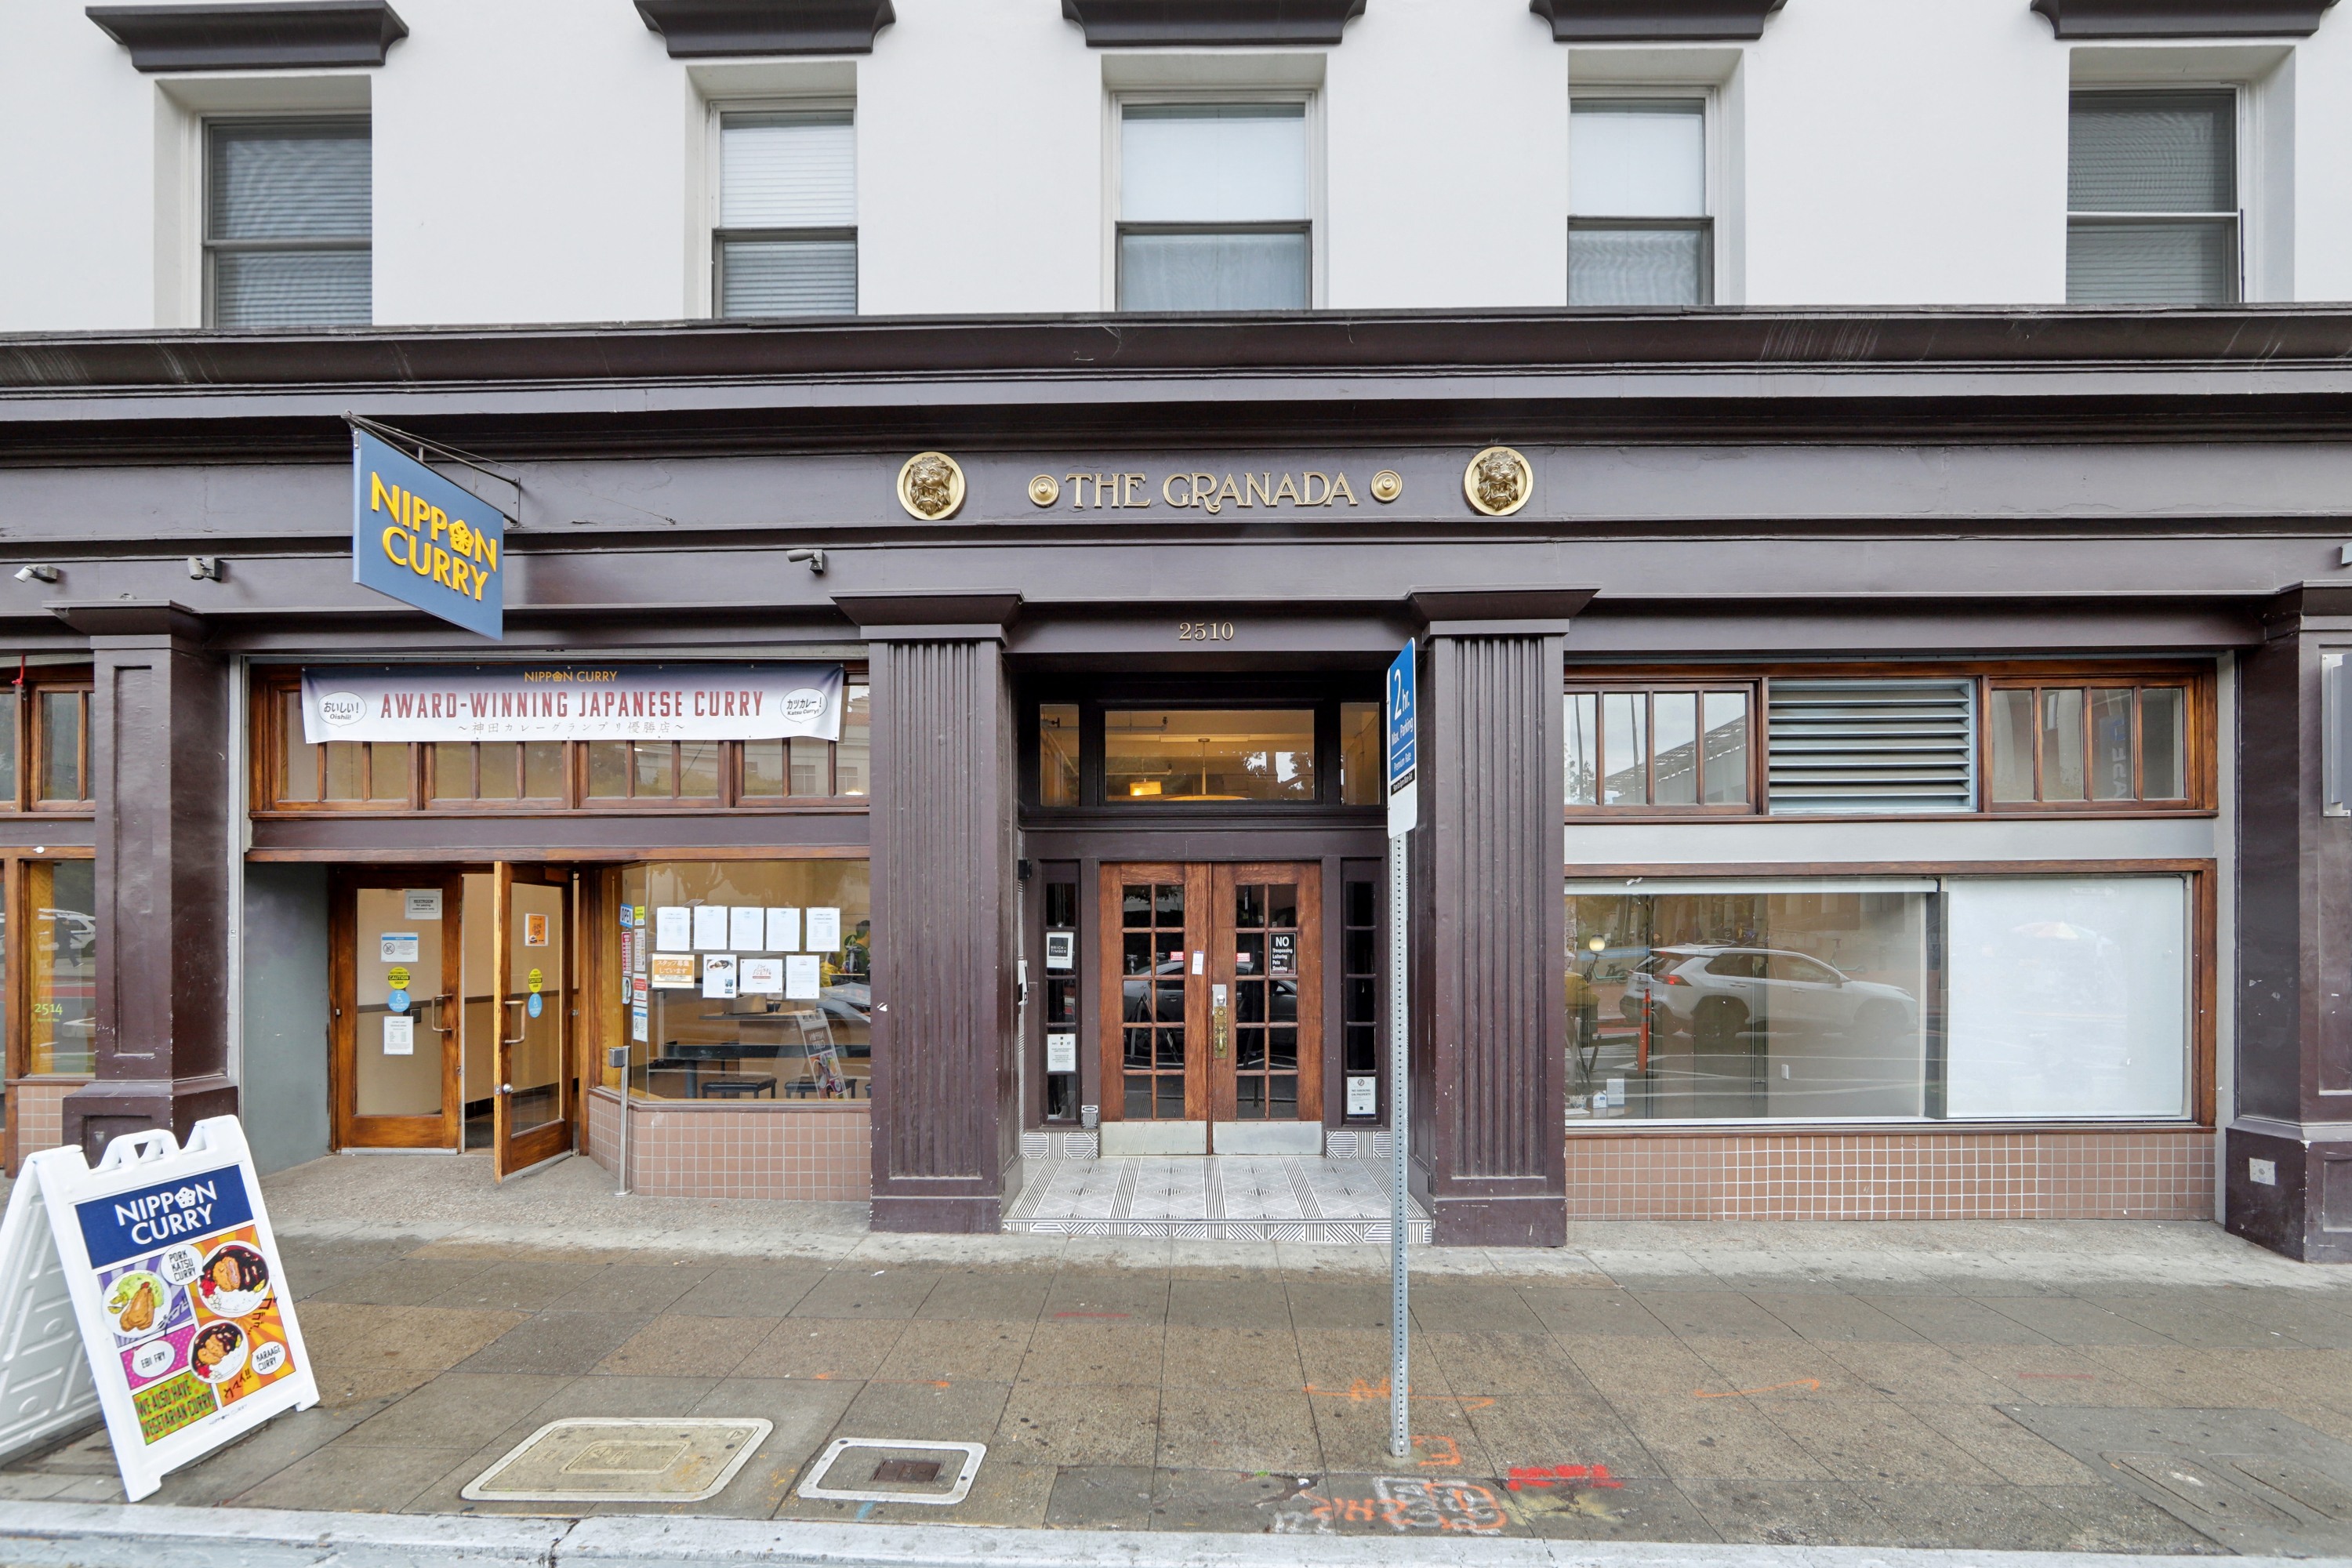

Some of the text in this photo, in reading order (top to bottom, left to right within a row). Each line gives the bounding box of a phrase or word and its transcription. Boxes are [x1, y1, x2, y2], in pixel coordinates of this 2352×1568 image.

[1065, 472, 1358, 514] THE GRANADA
[383, 526, 488, 601] CURRY
[1178, 622, 1234, 641] 2510
[577, 670, 618, 683] CURRY
[1393, 668, 1402, 720] 2
[380, 690, 764, 718] AWARD-WINNING JAPANESE CURRY
[1400, 717, 1413, 739] Parking
[1276, 936, 1290, 946] NO
[34, 1004, 63, 1015] 2514
[132, 1203, 212, 1245] CURRY
[169, 1250, 187, 1263] PORK
[172, 1258, 194, 1272] KATSU
[174, 1267, 196, 1282] CURRY
[141, 1352, 165, 1368] EBI FRY
[256, 1345, 281, 1362] KARAAGE
[258, 1357, 277, 1371] CURRY
[151, 1388, 171, 1409] ALSO
[171, 1380, 192, 1401] HAVE
